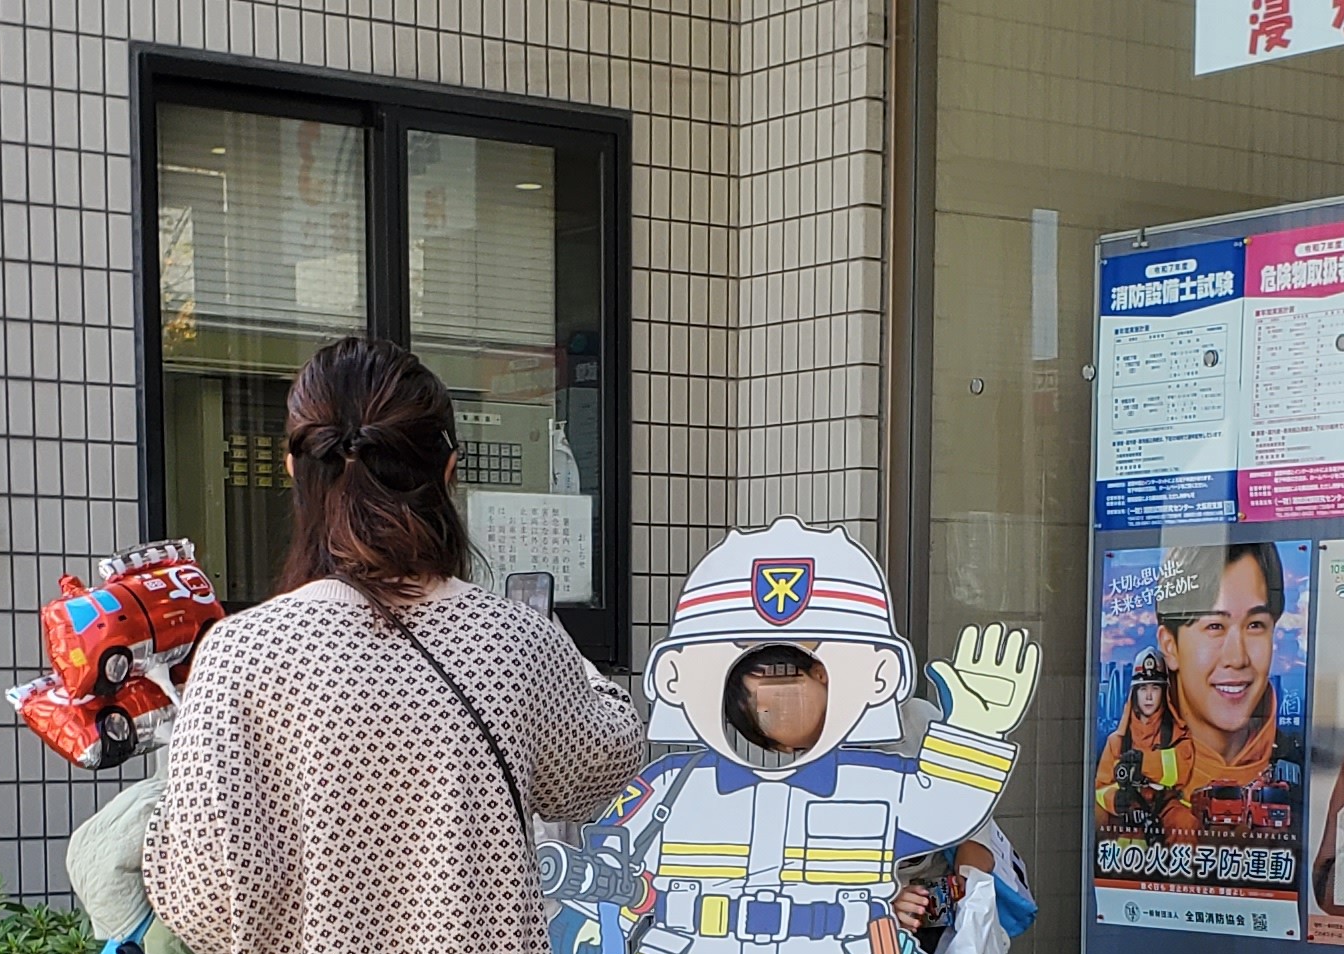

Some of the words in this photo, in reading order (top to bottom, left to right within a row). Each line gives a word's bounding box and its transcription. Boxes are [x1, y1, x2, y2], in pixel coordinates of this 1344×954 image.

[1111, 270, 1235, 312] 消防設備士試験
[1109, 559, 1184, 597] 大切な思い出と
[1110, 574, 1200, 616] 未来を守るために
[1098, 841, 1295, 882] 秋の火災予防運動
[1184, 910, 1246, 926] 全国消防協会
